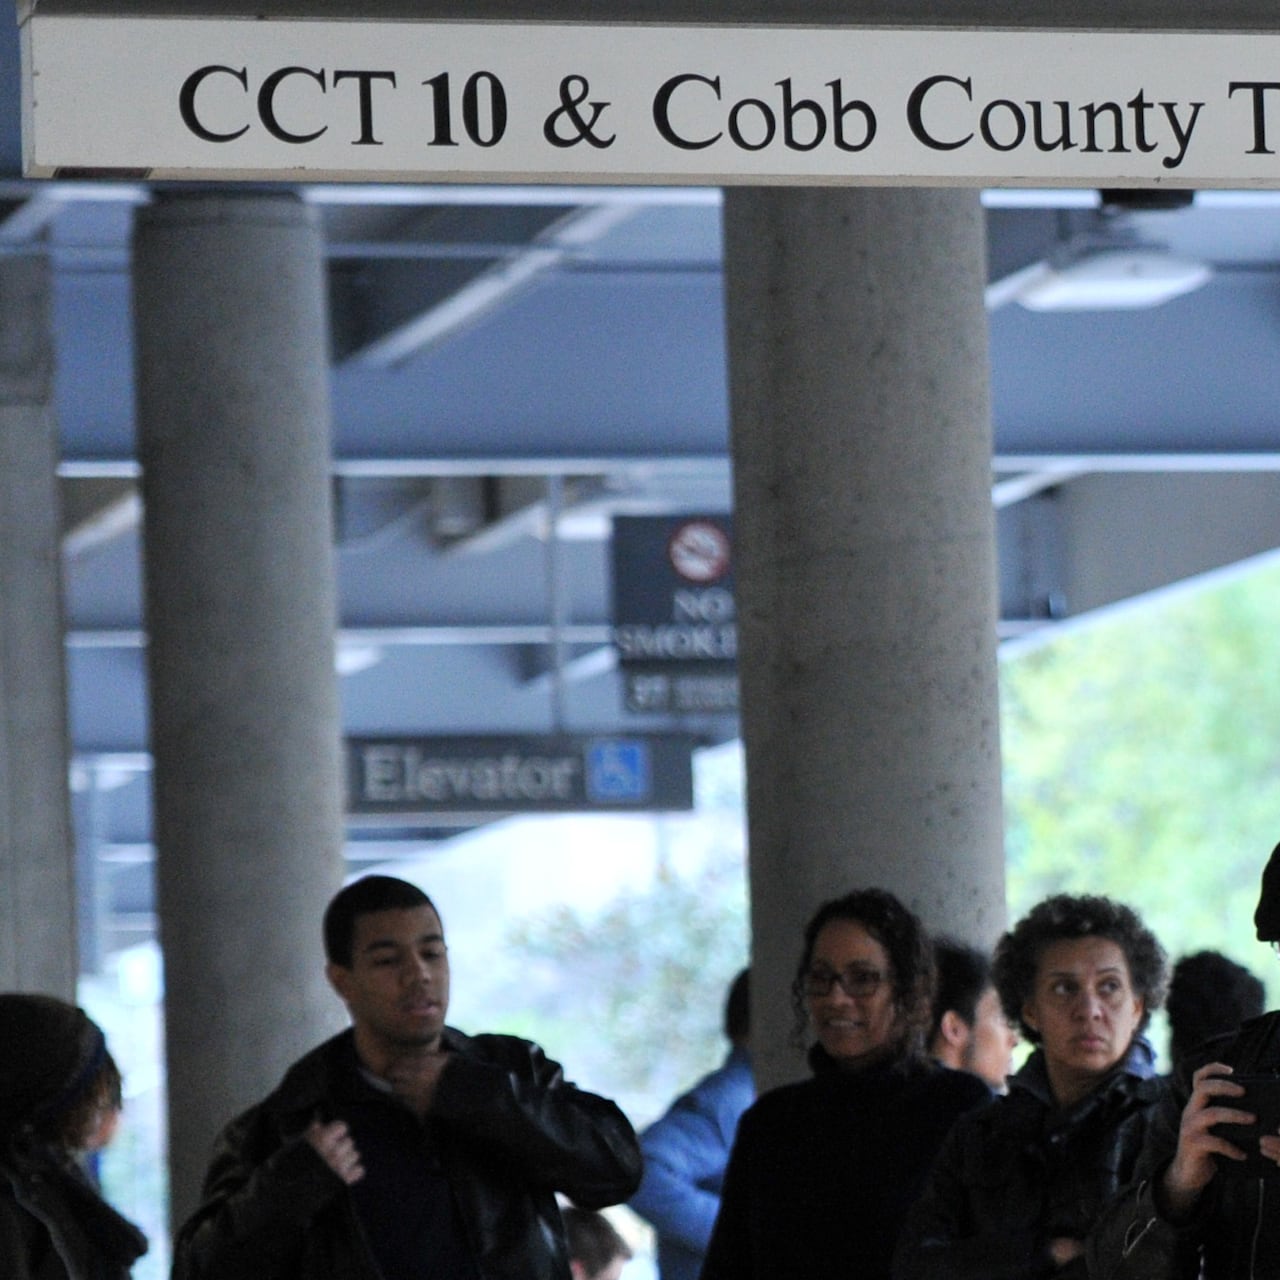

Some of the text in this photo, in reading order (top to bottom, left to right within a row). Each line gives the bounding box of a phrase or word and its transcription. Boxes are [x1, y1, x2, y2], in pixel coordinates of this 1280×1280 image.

[178, 64, 397, 146] CCT
[420, 70, 508, 148] 10
[542, 74, 617, 149] &
[652, 73, 878, 153] Cobb
[905, 74, 1206, 169] County
[674, 588, 736, 623] NO
[361, 743, 579, 802] Elevator
